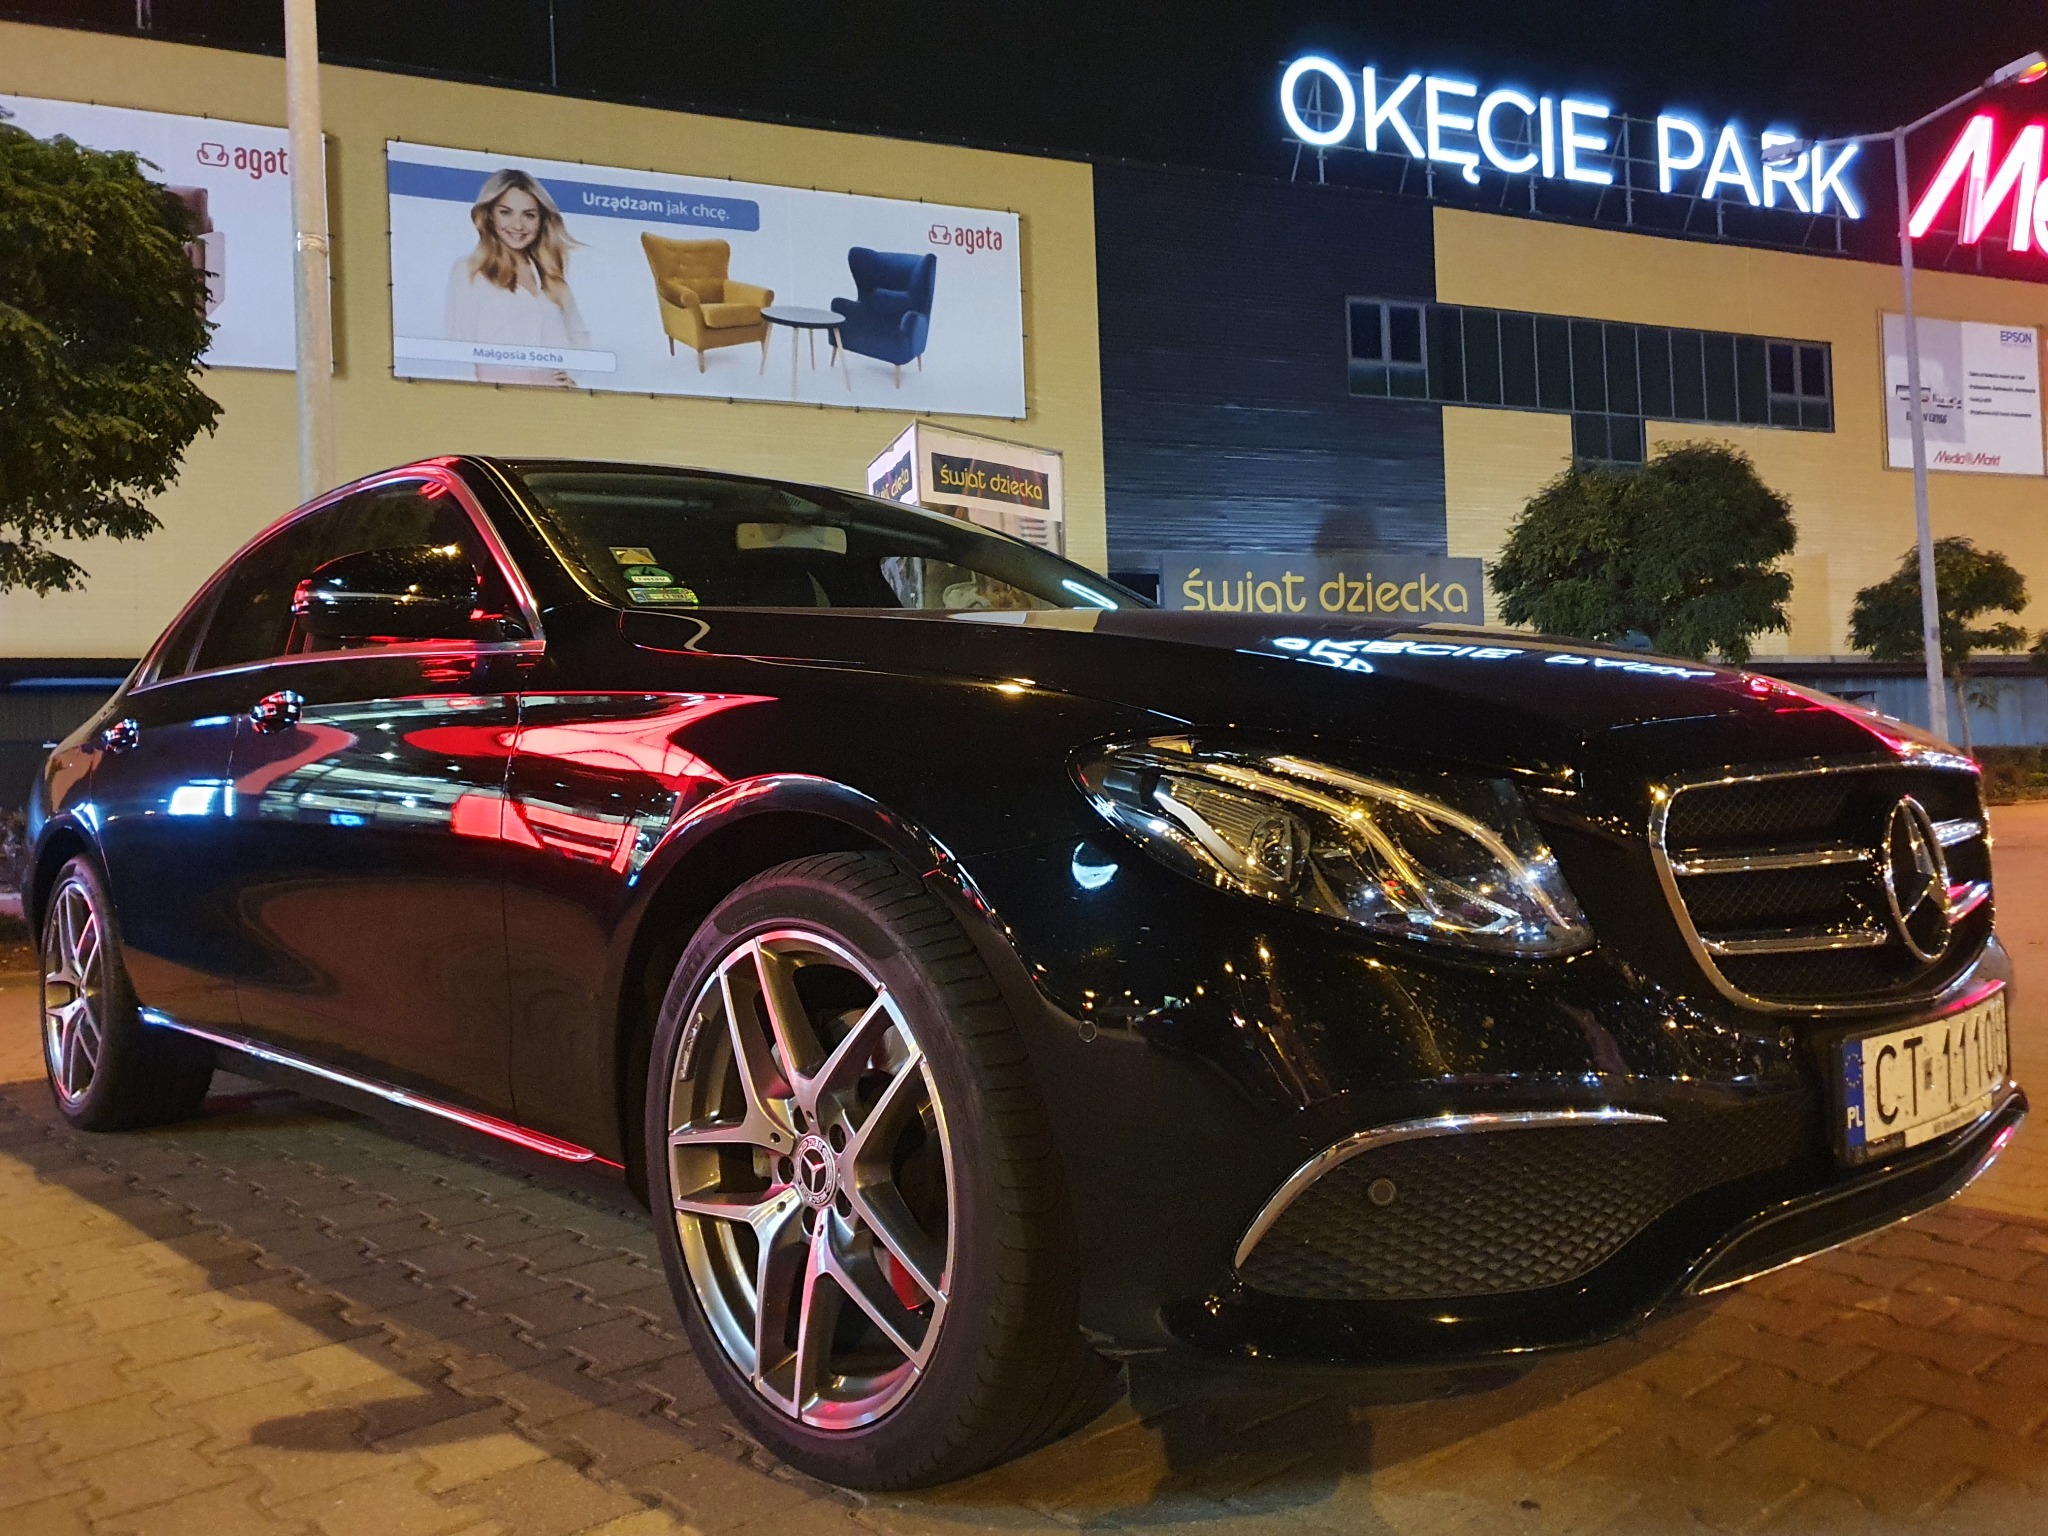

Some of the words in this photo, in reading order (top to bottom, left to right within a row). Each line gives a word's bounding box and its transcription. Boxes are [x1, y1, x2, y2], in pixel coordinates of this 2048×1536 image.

[1280, 56, 1614, 185] OKĘCIE
[1656, 113, 1862, 220] PARK
[233, 146, 289, 180] agat
[582, 191, 664, 213] Urządzam
[665, 199, 689, 217] jak
[691, 202, 731, 222] chcę.
[954, 226, 1003, 255] agata
[2000, 330, 2033, 344] EPSON
[528, 350, 564, 363] Socha
[1933, 450, 1965, 465] Media
[989, 473, 1043, 501] dziecka
[1318, 571, 1468, 614] dziecka
[1875, 1035, 1924, 1126] CT
[1846, 1105, 1864, 1129] PL
